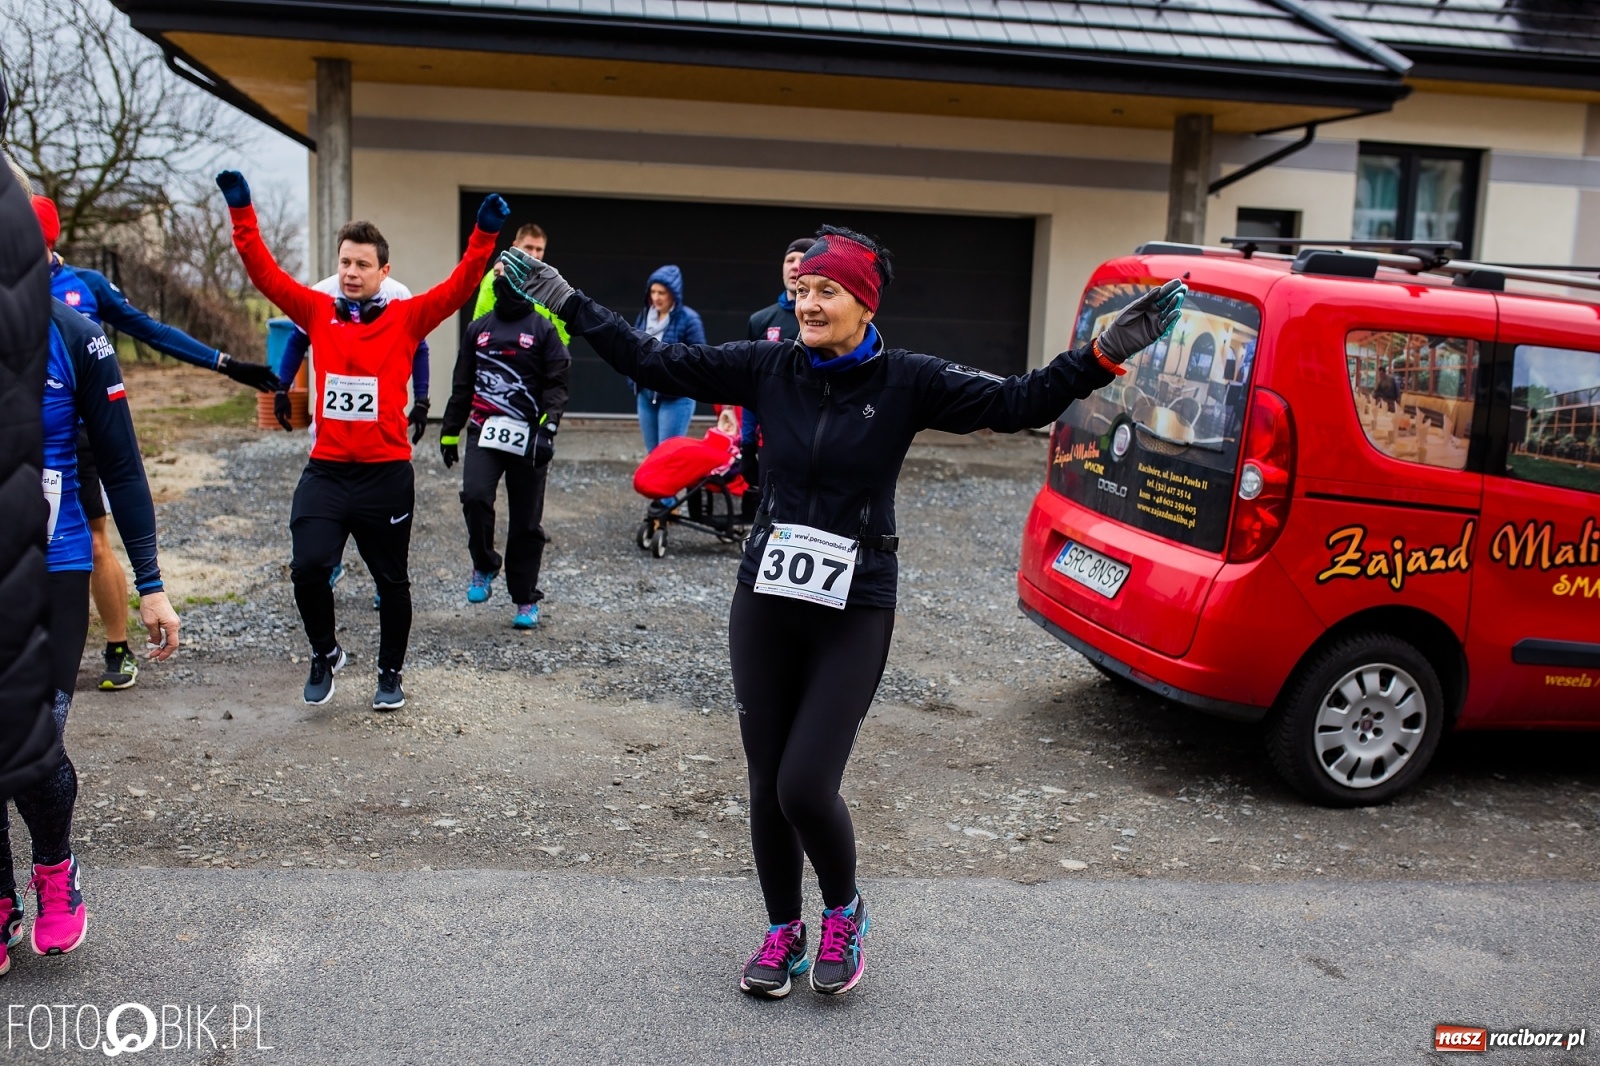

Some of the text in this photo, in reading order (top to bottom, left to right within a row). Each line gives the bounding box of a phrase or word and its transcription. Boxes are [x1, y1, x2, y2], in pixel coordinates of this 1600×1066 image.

[326, 390, 374, 413] 232
[484, 426, 525, 448] 382
[1098, 478, 1127, 497] DOBLO
[1146, 479, 1155, 488] tel.
[1155, 480, 1167, 493] (32)
[1176, 489, 1184, 498] 25
[1184, 491, 1192, 501] 14
[1169, 471, 1183, 483] Jana
[1201, 480, 1208, 490] II
[1162, 497, 1174, 508] 602
[1185, 504, 1197, 516] 603
[1317, 519, 1475, 590] Zajazd
[763, 548, 849, 592] 307
[1063, 546, 1093, 573] SRC
[1087, 558, 1124, 589] 8NS9
[1545, 673, 1592, 688] wesela
